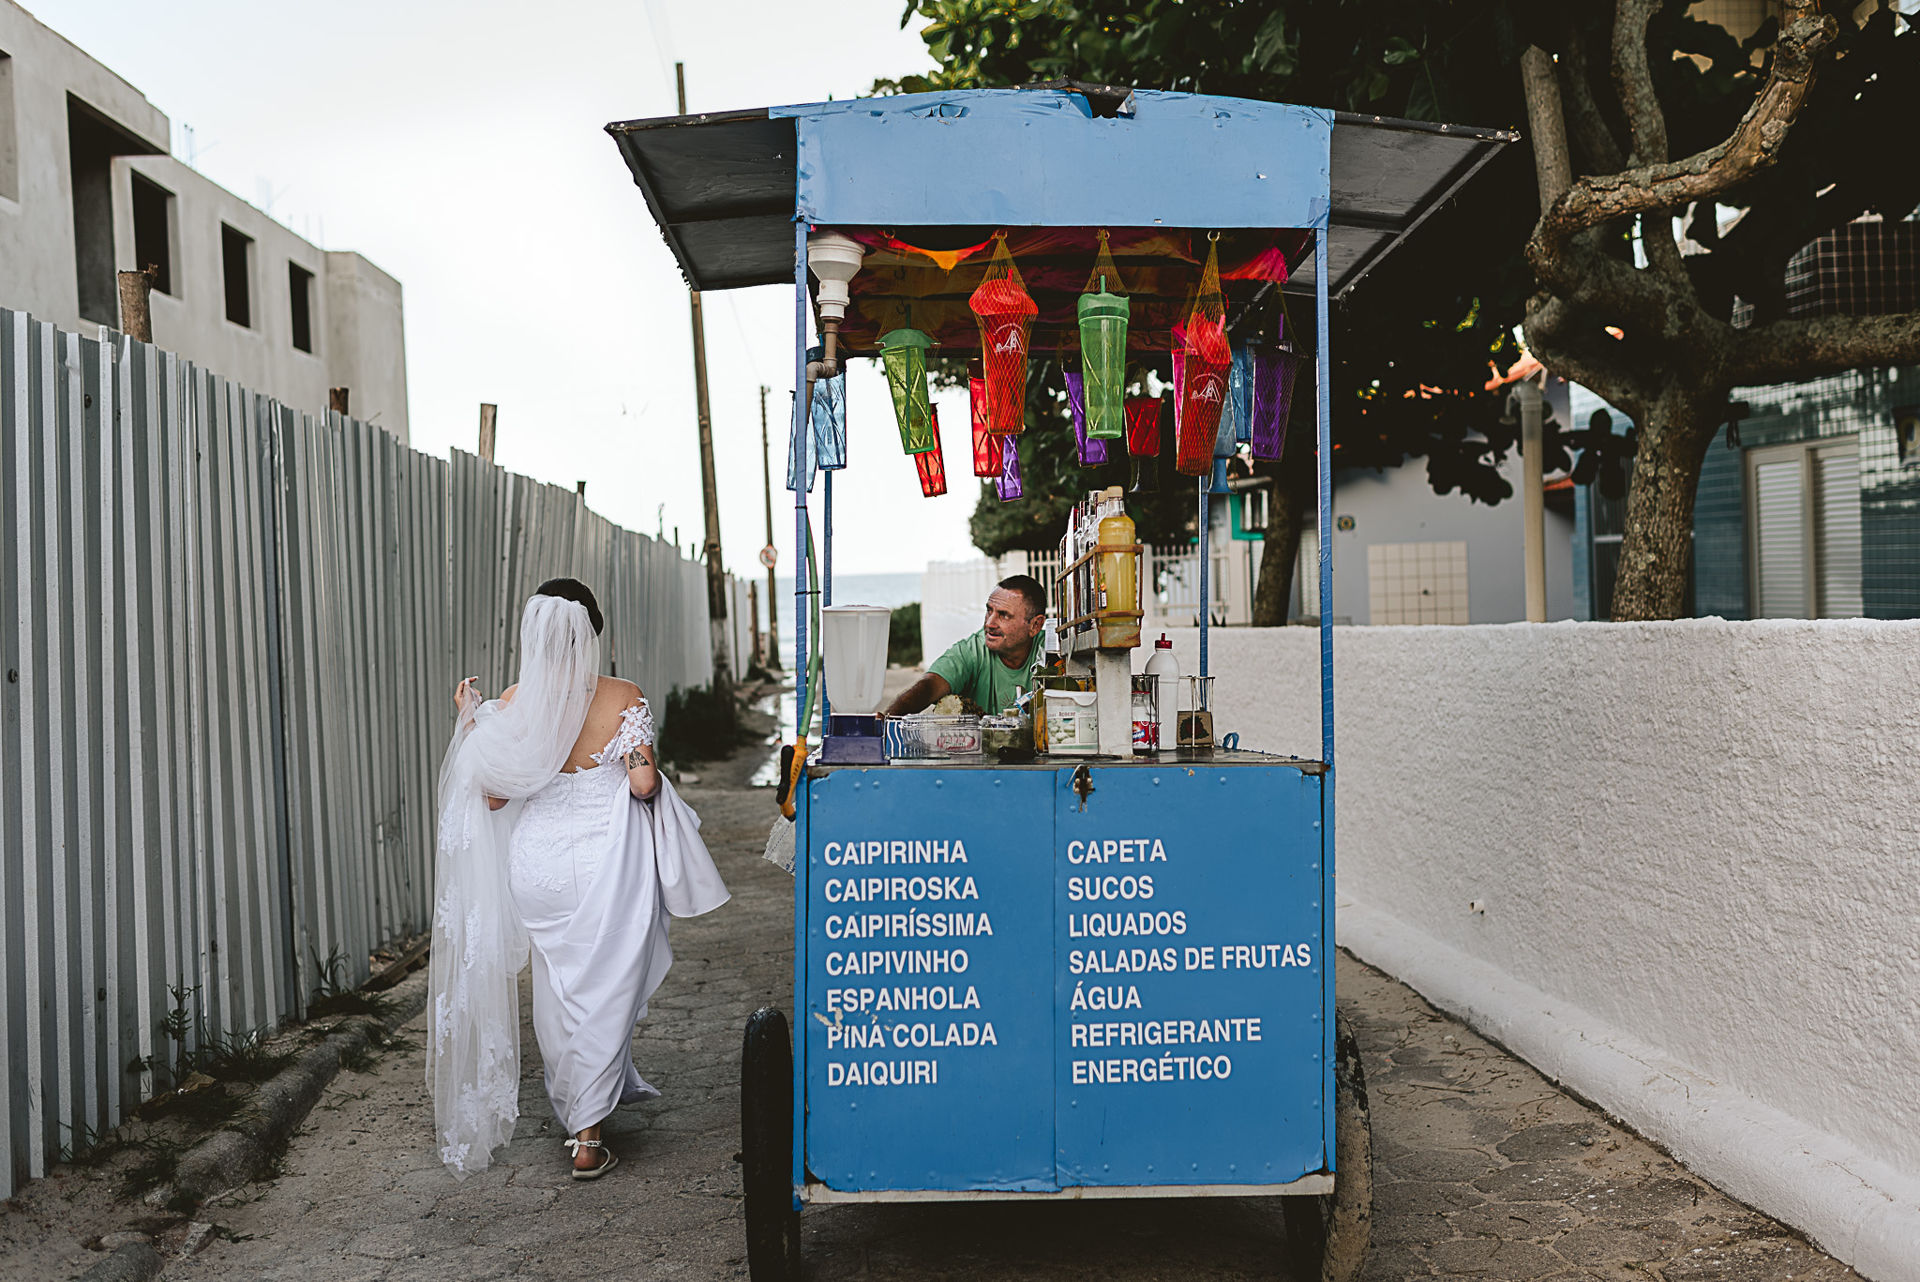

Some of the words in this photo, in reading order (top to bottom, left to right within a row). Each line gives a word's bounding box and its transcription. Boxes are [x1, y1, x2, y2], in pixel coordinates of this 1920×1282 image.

[824, 839, 968, 866] CAIPIRINHA
[1067, 838, 1167, 865] CAPETA
[824, 876, 979, 903] CAIPIROSKA
[1068, 875, 1154, 901] SUCOS
[825, 907, 994, 939] CAIPIRÍSSIMA
[1069, 910, 1187, 938] LIQUADOS
[825, 949, 969, 976] CAIPIVINHO
[1069, 948, 1178, 974] SALADAS
[1184, 946, 1215, 971] DE
[1221, 943, 1312, 970] FRUTAS
[827, 986, 981, 1012] ESPANHOLA
[1069, 980, 1142, 1011] ÁGUA
[892, 1022, 998, 1048] COLADA
[1071, 1017, 1262, 1048] REFRIGERANTE
[828, 1060, 938, 1087] DAIQUIRI
[1072, 1050, 1232, 1084] ENERGÉTICO
